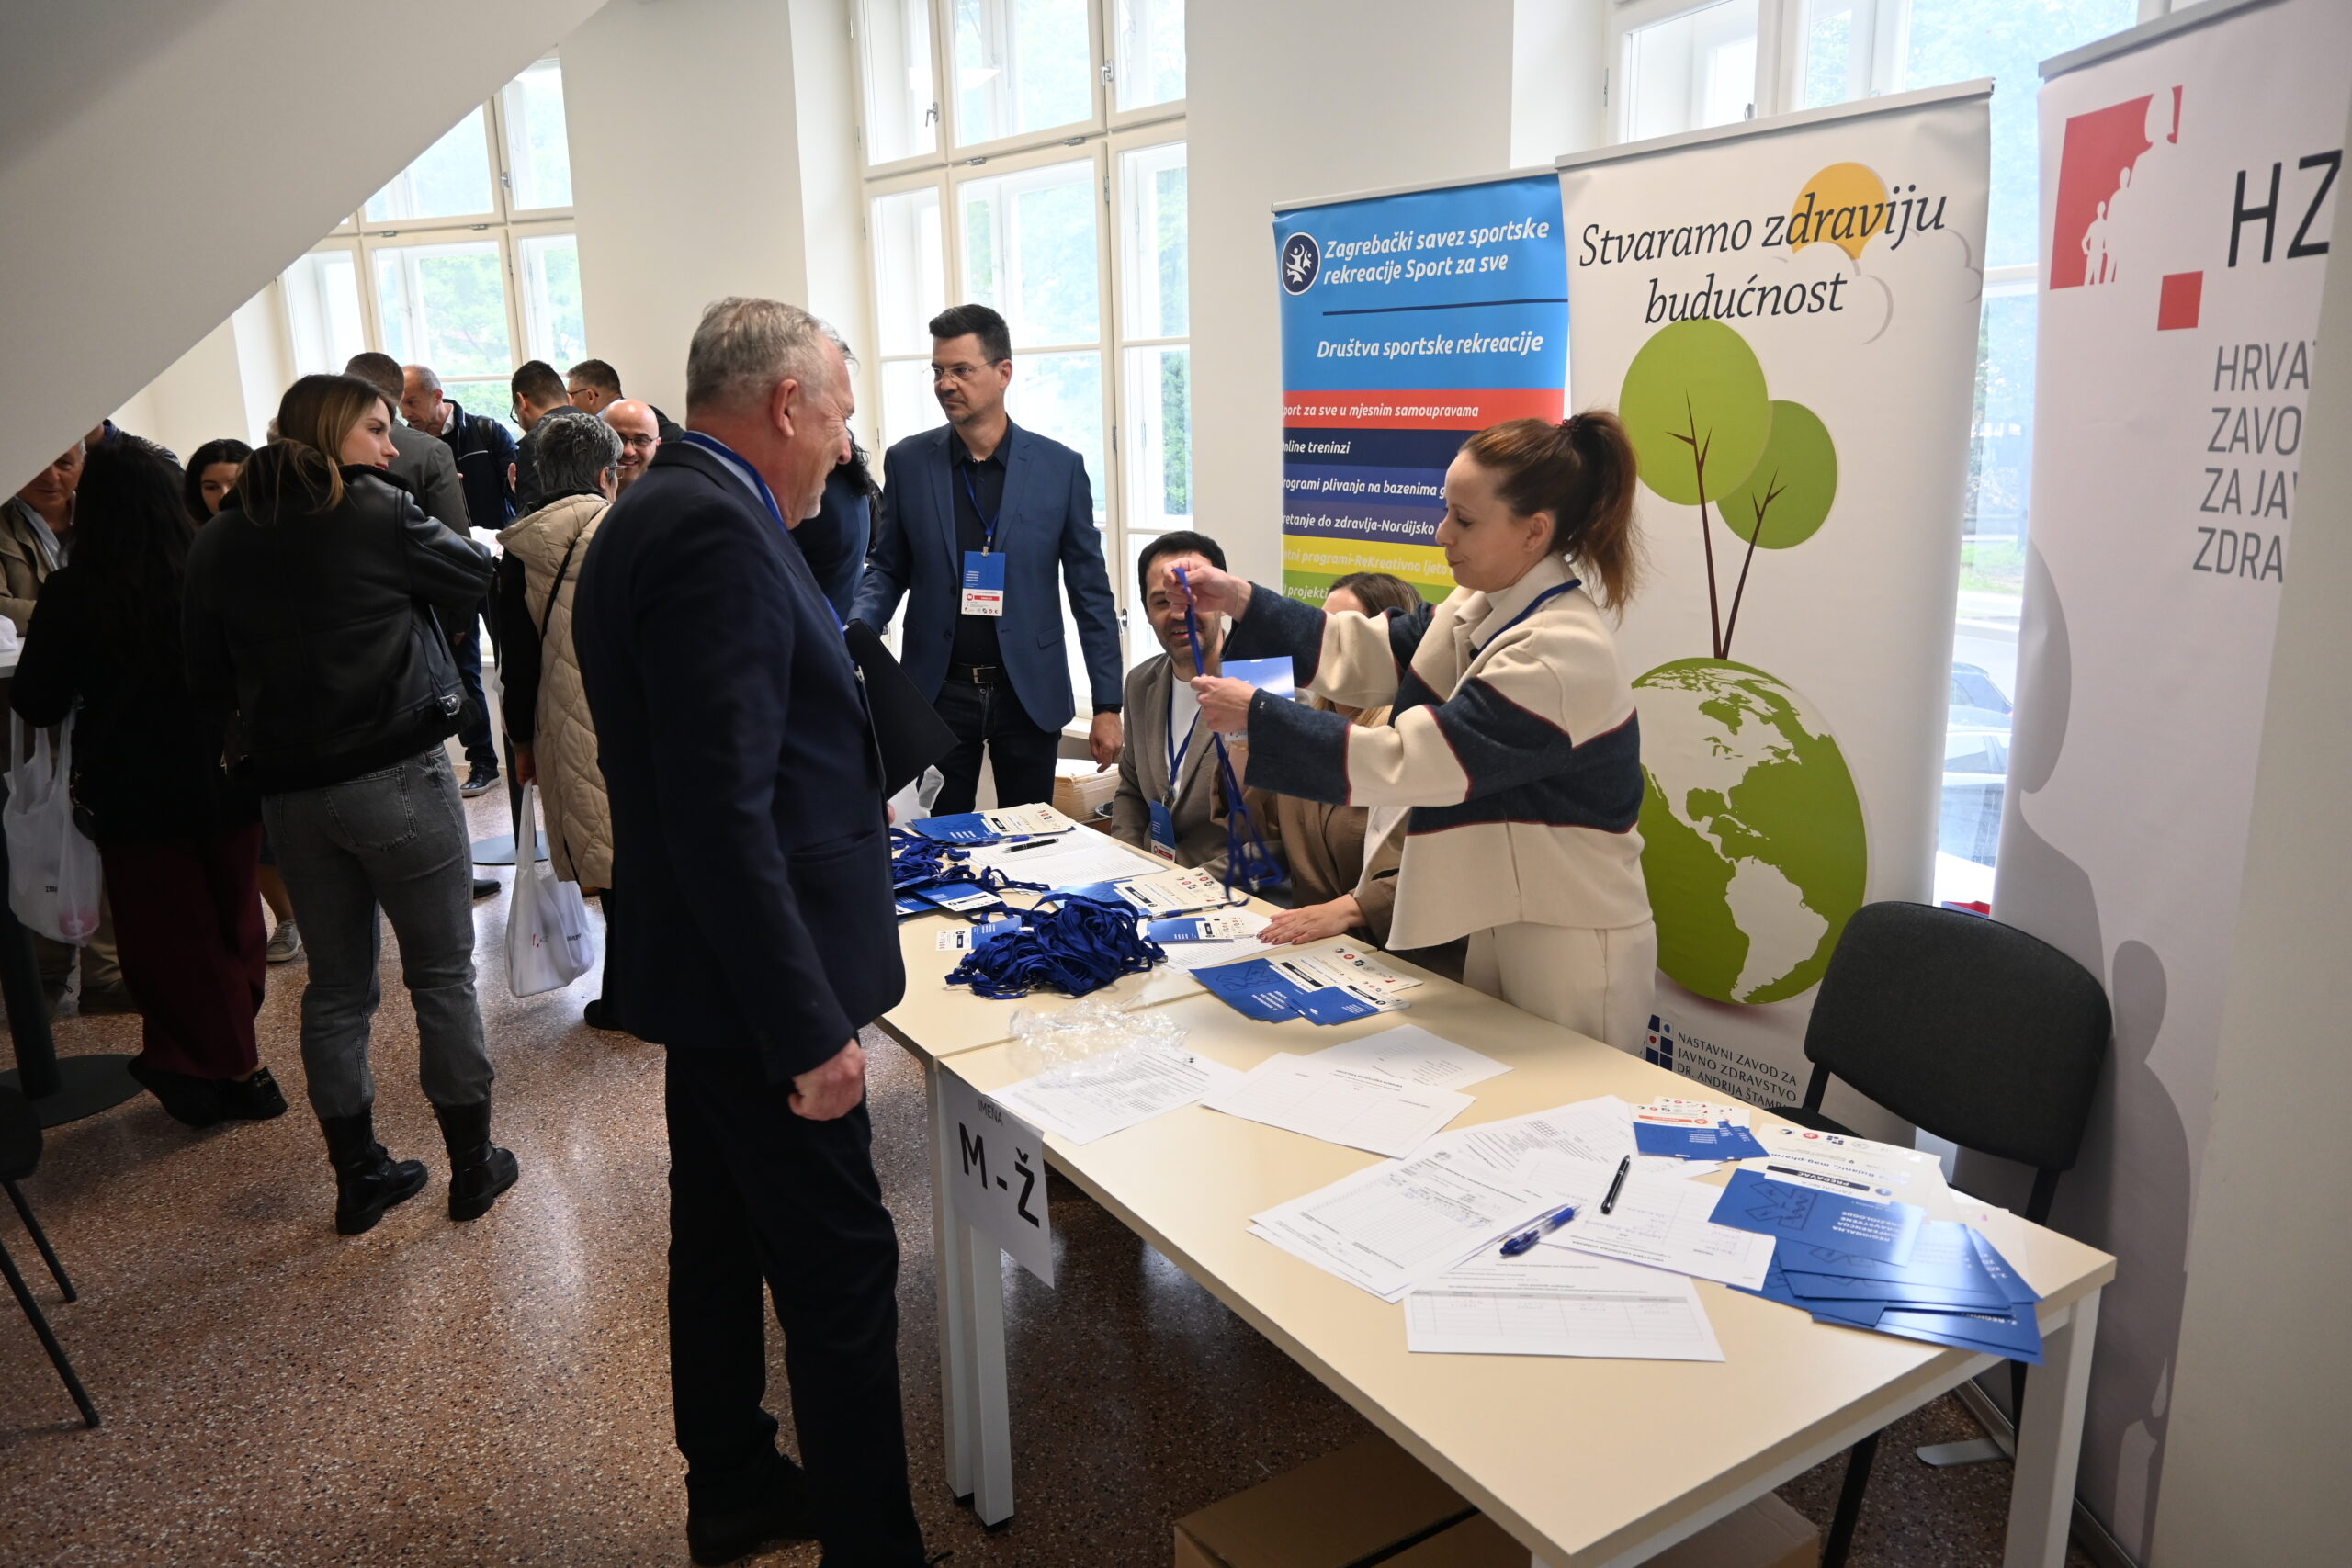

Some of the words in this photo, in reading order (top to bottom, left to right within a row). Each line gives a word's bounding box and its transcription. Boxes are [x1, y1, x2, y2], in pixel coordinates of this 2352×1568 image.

[1324, 231, 1414, 261] Zagrebački
[1416, 228, 1464, 251] savez
[1468, 217, 1550, 246] sportske
[1578, 220, 1752, 267] Stvaramo
[1761, 184, 1948, 252] zdraviju
[1323, 262, 1401, 286] rekreacije
[1405, 257, 1452, 282] Sport
[1455, 256, 1476, 274] za
[1480, 254, 1509, 272] sve
[1645, 272, 1848, 324] budućnost
[1317, 337, 1380, 358] Društva
[1383, 334, 1453, 360] sportske
[1456, 330, 1544, 356] rekreacije
[2213, 340, 2316, 393] HRVA
[1303, 406, 1317, 416] za
[1318, 405, 1338, 416] sve
[1340, 406, 1347, 416] u
[1349, 402, 1393, 419] mjesnim
[1395, 404, 1479, 419] samoupravama
[1307, 441, 1351, 454] treninzi
[1283, 477, 1321, 491] rogrami
[1322, 478, 1365, 494] plivanja
[1367, 483, 1381, 493] na
[1383, 480, 1437, 496] bazenima
[2200, 467, 2242, 514] ZA
[2250, 469, 2297, 520] JA
[1283, 513, 1316, 528] retanje
[1318, 514, 1332, 527] do
[1334, 515, 1435, 536] zdravlja-Nordijsko
[1678, 1032, 1733, 1060] NASTAVNI
[1736, 1054, 1779, 1077] ZAVOD
[1781, 1071, 1797, 1087] ZA
[1678, 1047, 1717, 1070] JAVNO
[1720, 1065, 1797, 1102] ZDRAVSTVO
[1677, 1063, 1695, 1078] DR.
[1698, 1071, 1743, 1097] ANDRIJA
[1746, 1087, 1786, 1108] ŠTAMP
[978, 1100, 1003, 1125] IMENA
